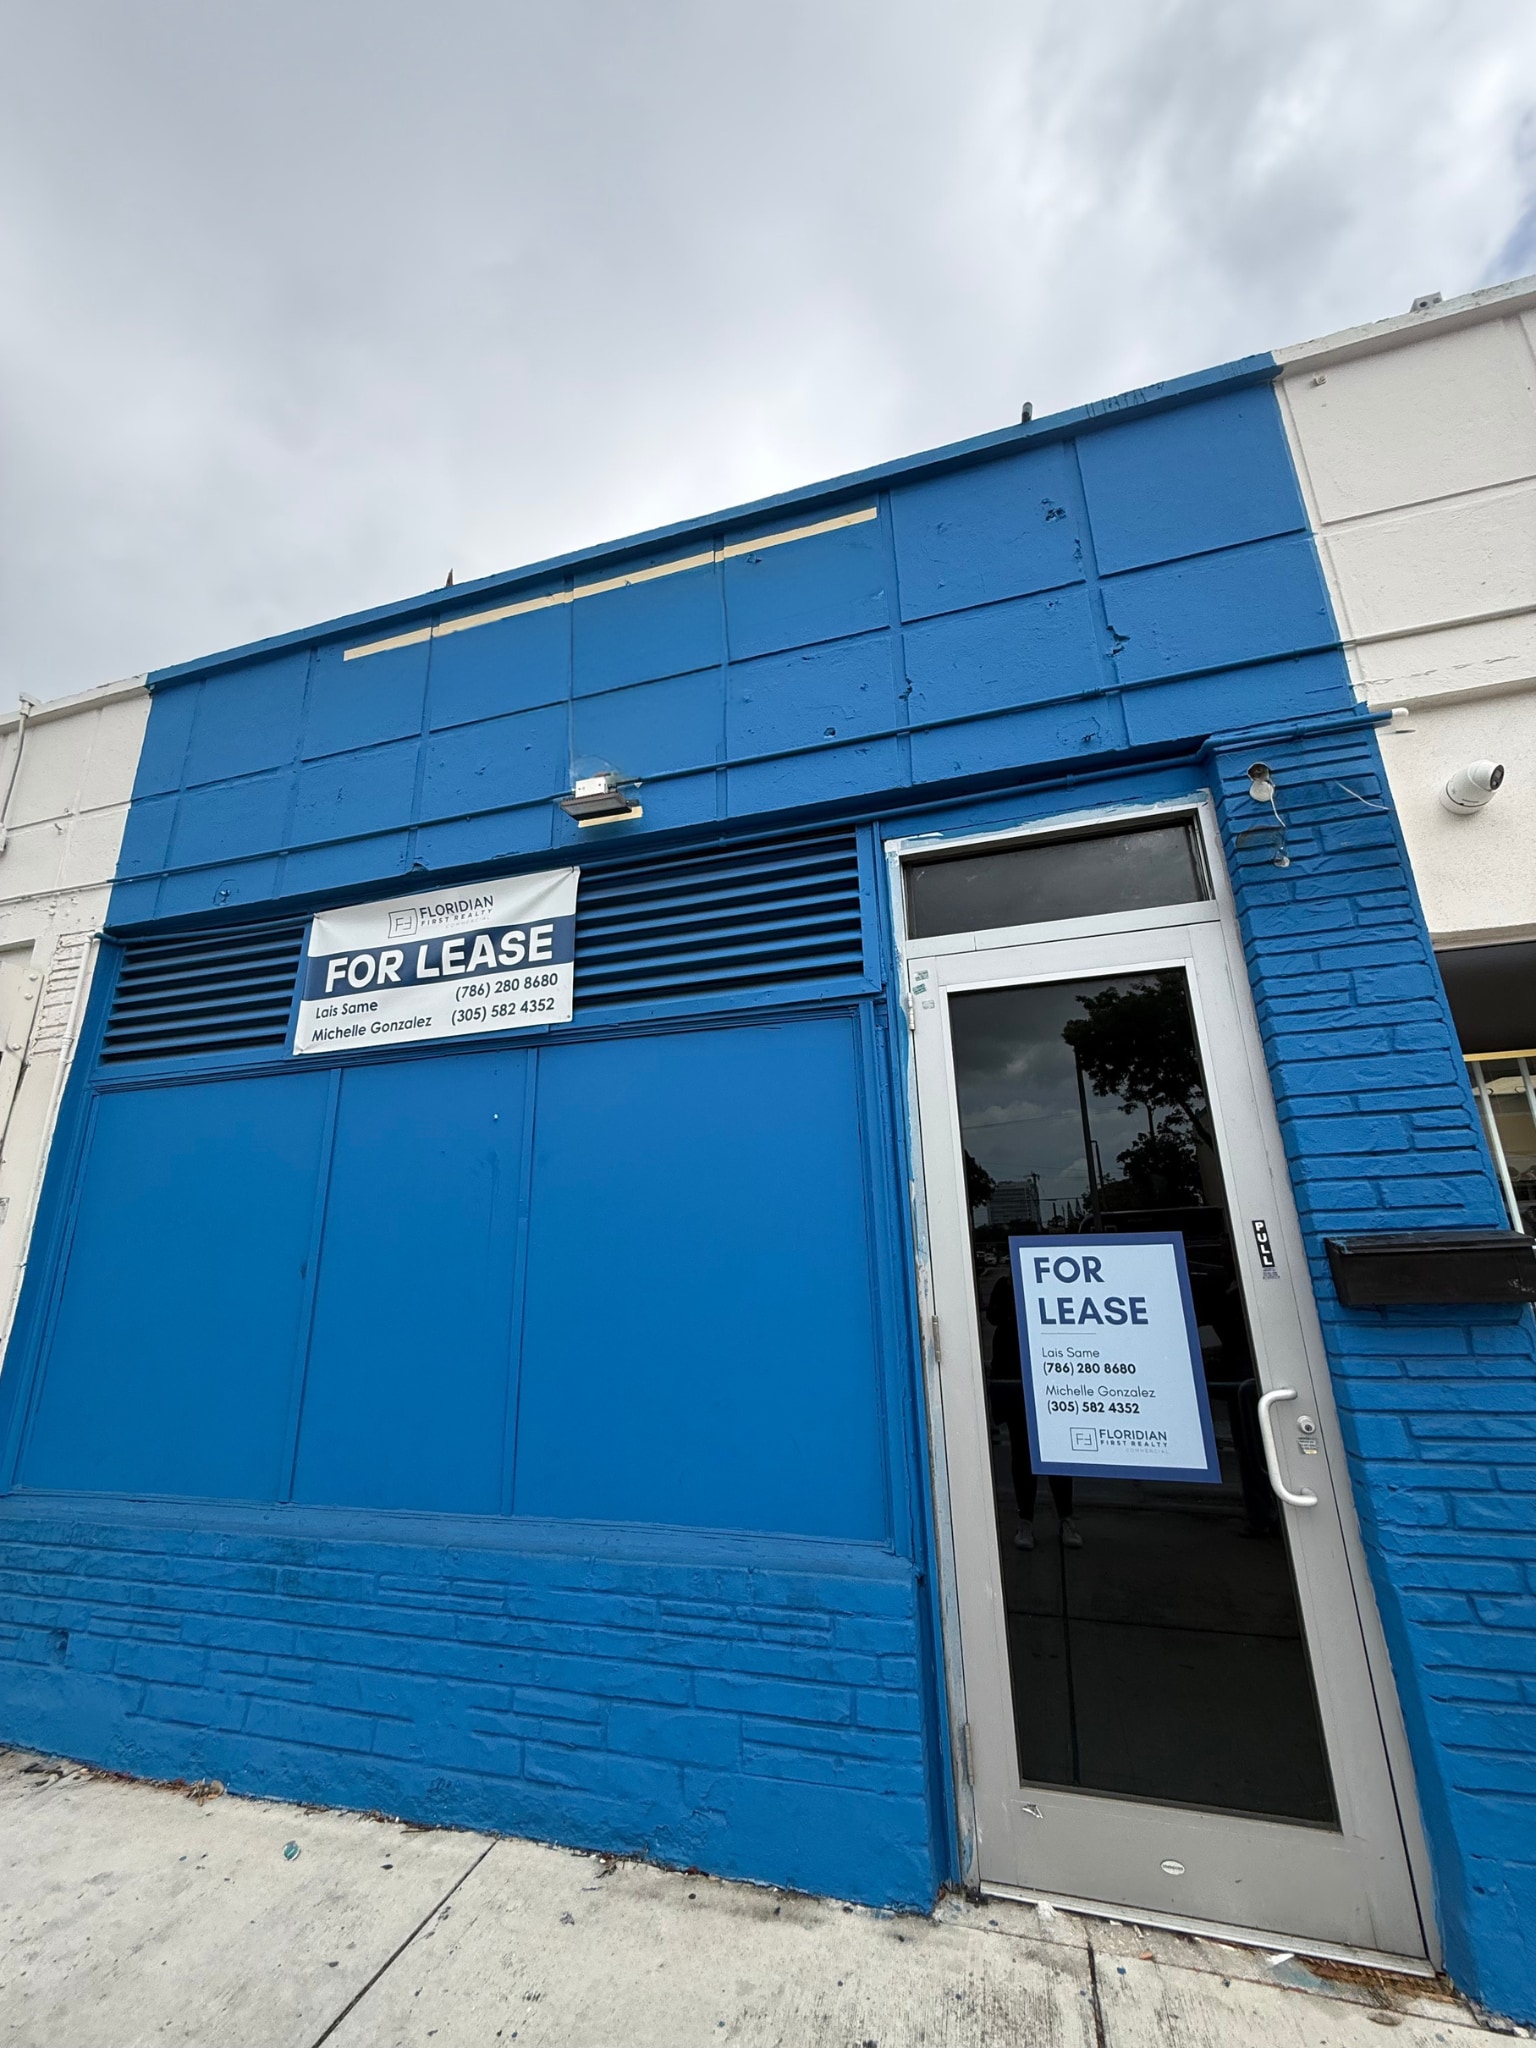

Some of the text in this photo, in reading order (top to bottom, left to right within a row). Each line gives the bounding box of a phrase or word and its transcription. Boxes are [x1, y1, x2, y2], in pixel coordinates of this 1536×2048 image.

[420, 895, 494, 918] FLORIDIAN
[420, 909, 493, 926] FIRST REALTY
[325, 924, 554, 992] FOR LEASE
[455, 973, 558, 1002] (786) 280 8680
[316, 1000, 378, 1019] Lais Same
[451, 998, 555, 1026] (305) 582 4352
[312, 1015, 432, 1042] Michelle Gonzalez
[1254, 1221, 1273, 1266] PULL
[1034, 1256, 1104, 1284] FOR
[1038, 1296, 1149, 1325] LEASE
[1042, 1347, 1100, 1358] Lais Same
[1043, 1362, 1136, 1376] (786) 280 8680
[1046, 1385, 1156, 1398] Michelle Gonzalez
[1047, 1401, 1140, 1415] (305) 582 4352
[1099, 1429, 1167, 1440] FLORIDIAN
